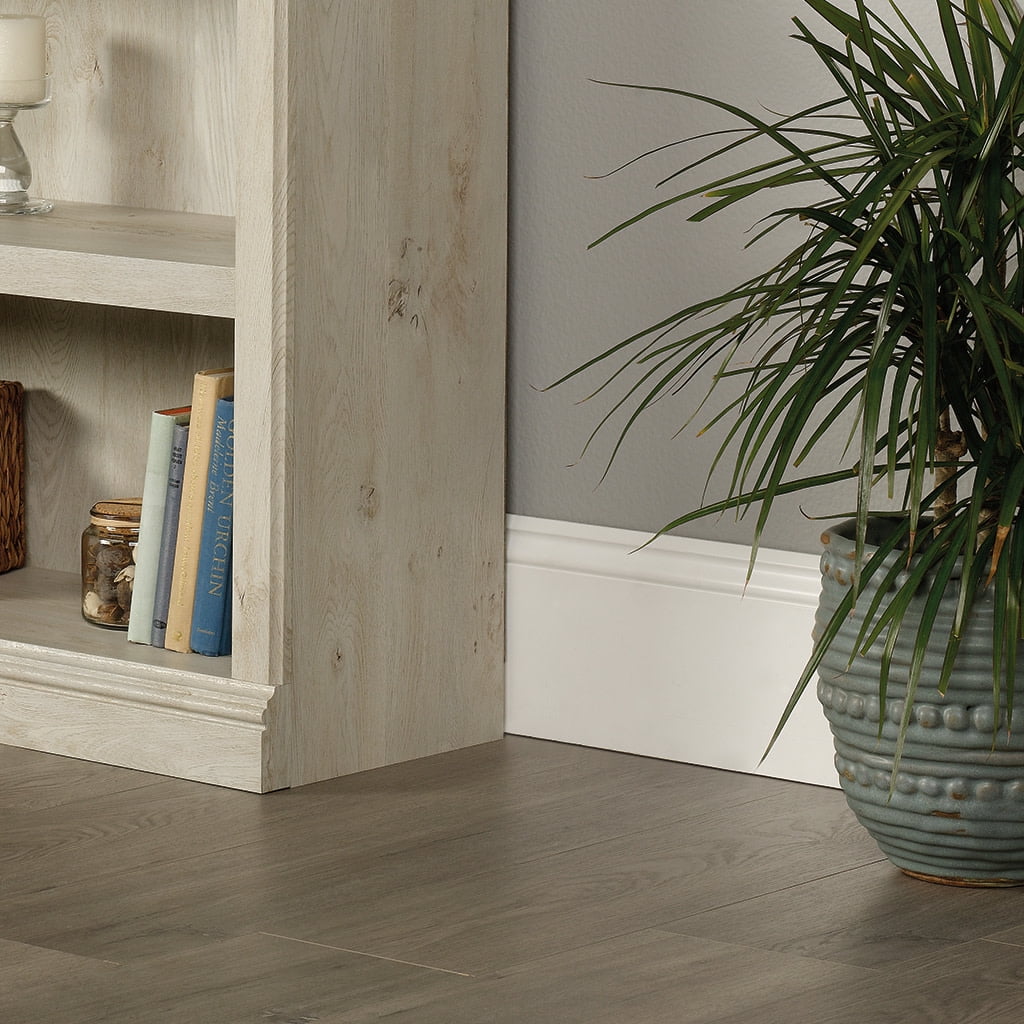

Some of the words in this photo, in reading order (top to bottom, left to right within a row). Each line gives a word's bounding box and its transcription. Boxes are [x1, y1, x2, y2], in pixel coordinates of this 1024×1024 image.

[212, 415, 227, 475] Madeleine
[207, 480, 217, 513] Brent
[208, 515, 231, 597] URCHIN
